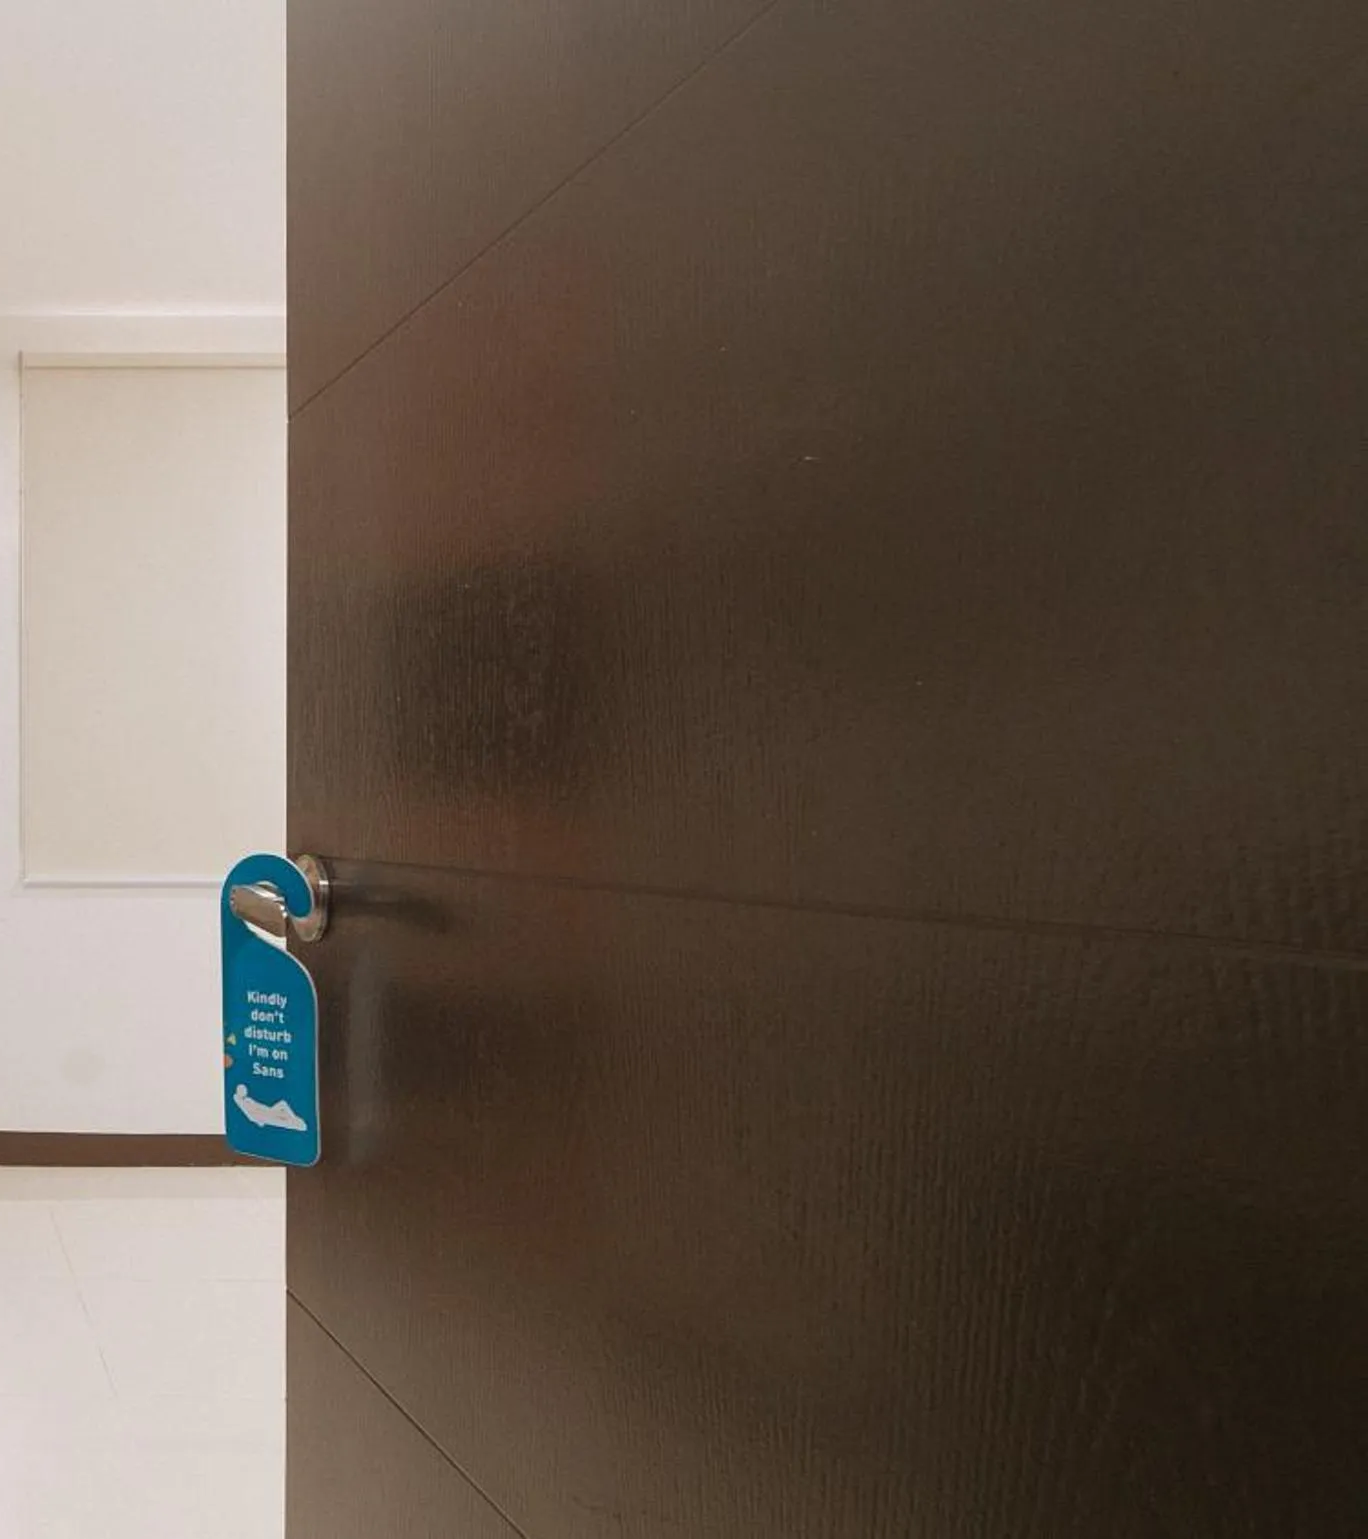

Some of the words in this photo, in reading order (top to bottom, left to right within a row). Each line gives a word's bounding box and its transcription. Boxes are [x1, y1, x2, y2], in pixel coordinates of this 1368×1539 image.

[247, 991, 288, 1009] Kindly
[251, 1009, 285, 1024] don't
[244, 1026, 292, 1044] disturb
[248, 1043, 269, 1058] I'm
[272, 1048, 288, 1061] on
[252, 1062, 285, 1079] Sans
